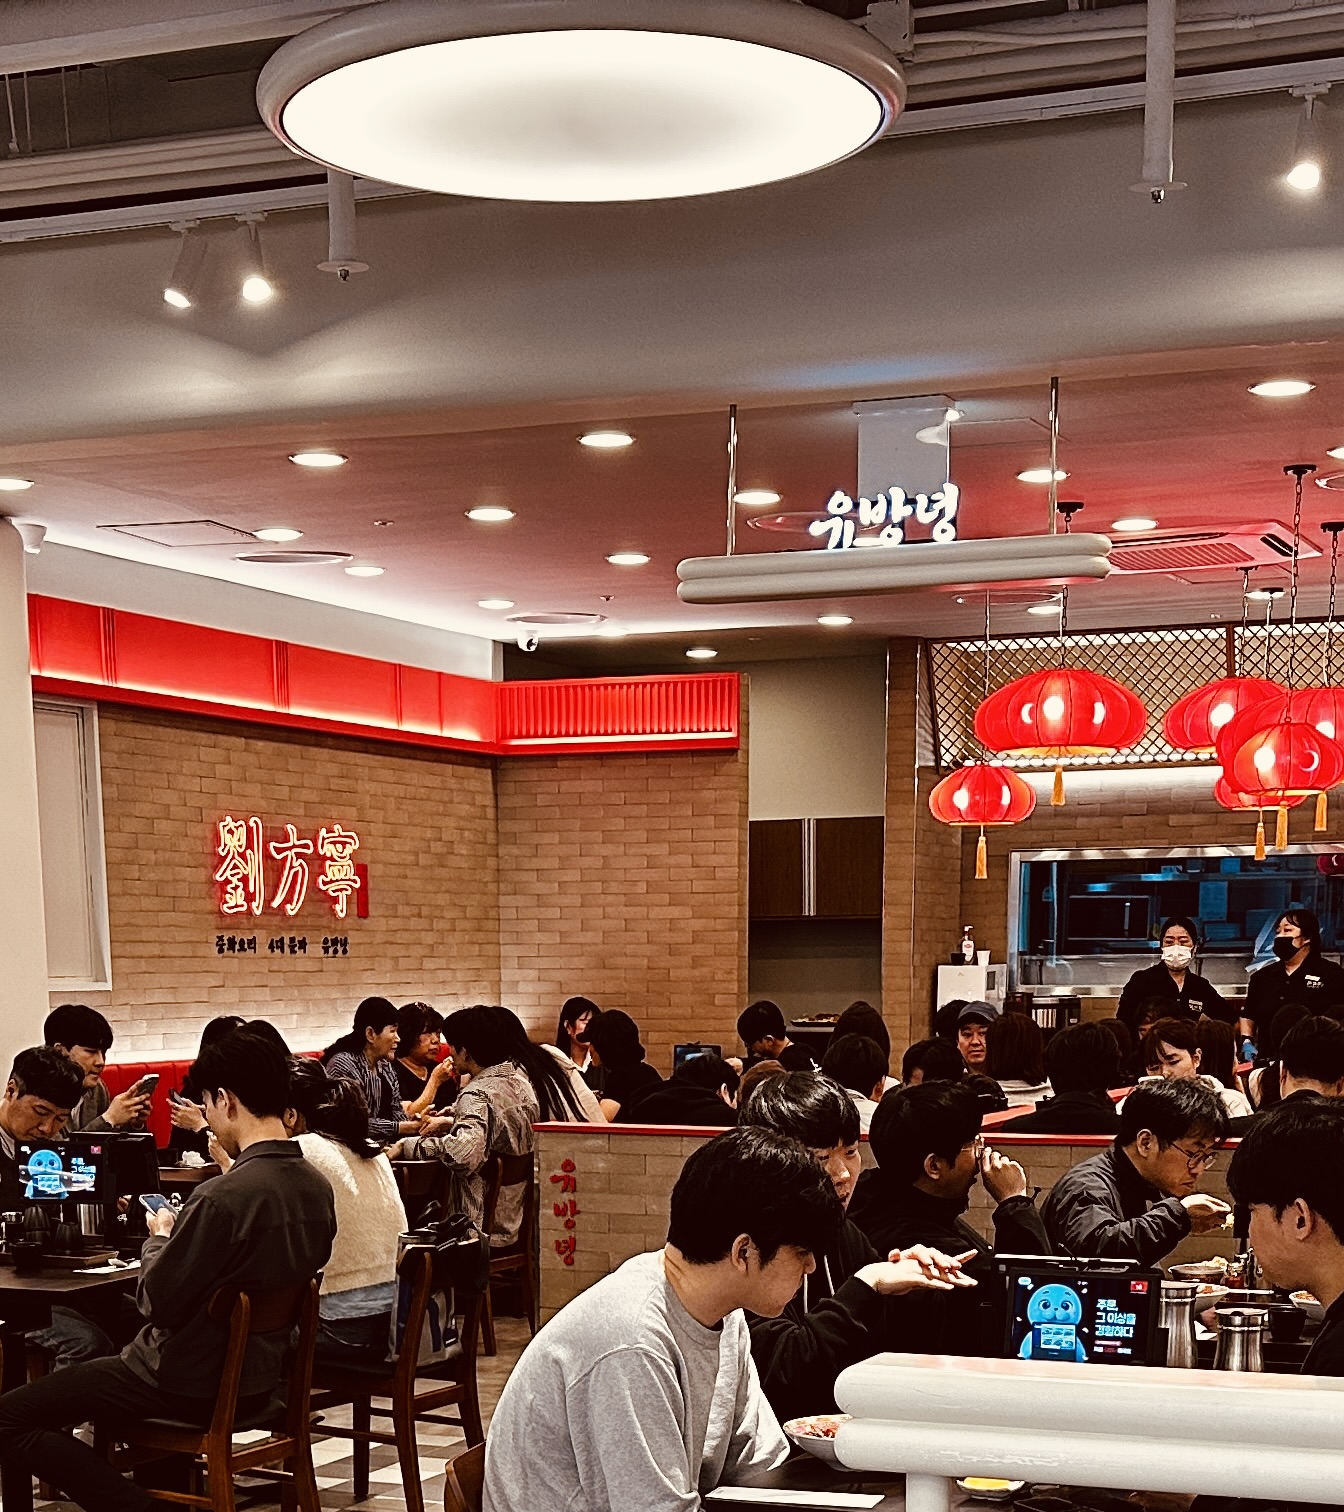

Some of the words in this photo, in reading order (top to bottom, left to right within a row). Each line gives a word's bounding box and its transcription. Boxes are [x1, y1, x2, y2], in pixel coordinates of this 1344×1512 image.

[809, 482, 959, 550] 유방녕
[549, 1159, 581, 1266] 유방녕
[1095, 1312, 1106, 1323] 그
